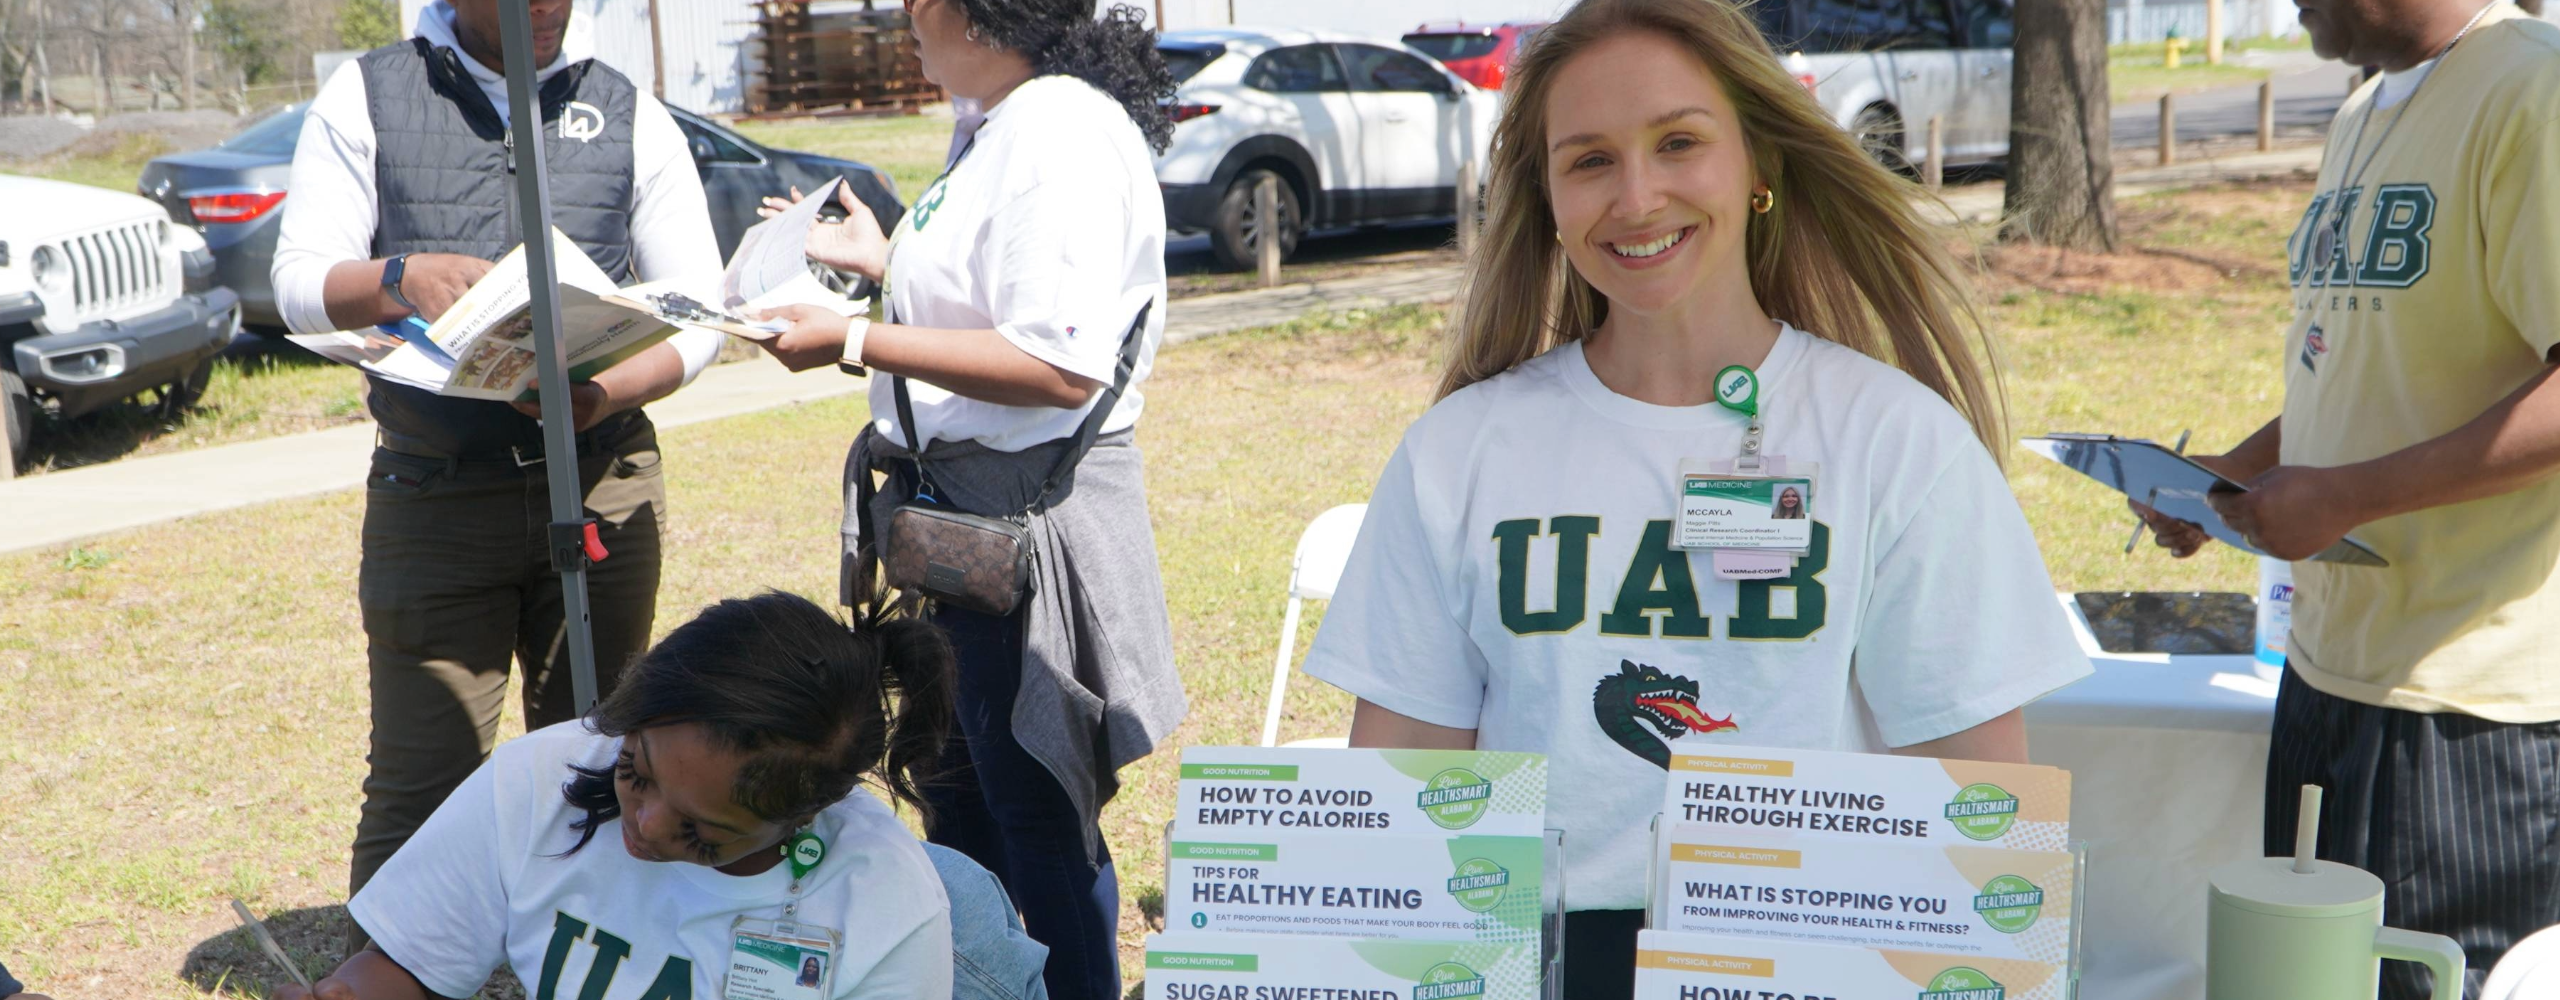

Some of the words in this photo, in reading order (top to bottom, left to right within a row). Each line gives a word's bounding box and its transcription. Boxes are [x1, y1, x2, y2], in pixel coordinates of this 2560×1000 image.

[2287, 183, 2438, 290] UAB
[448, 325, 472, 348] WHAT
[472, 318, 481, 330] IS
[479, 284, 516, 318] STOPPING
[517, 273, 528, 285] YO
[1722, 375, 1748, 398] UAB
[1709, 481, 1752, 489] MEDICINE
[1491, 514, 1831, 642] UAB
[1203, 768, 1226, 776] GOOD
[1228, 768, 1270, 776] NUTRITION
[1687, 759, 1728, 769] PHYSICAL
[1730, 761, 1769, 771] ACTIVITY
[1200, 787, 1257, 804] HOW
[1263, 788, 1293, 805] TO
[1297, 789, 1373, 806] AVOID
[1421, 784, 1489, 806] HEALTHSMART
[1684, 782, 1796, 805] HEALTHY
[1801, 790, 1885, 812] LIVING
[1948, 800, 2016, 817] HEALTHSMART
[1198, 808, 1274, 826] EMPTY
[1278, 810, 1390, 829] CALORIES
[1682, 804, 1804, 829] THROUGH
[1809, 813, 1929, 837] EXERCISE
[797, 845, 819, 858] UAB
[1189, 847, 1214, 855] GOOD
[1216, 848, 1260, 856] NUTRITION
[1695, 849, 1737, 860] PHYSICAL
[1739, 852, 1778, 862] ACTIVITY
[1193, 866, 1225, 879] TIPS
[1229, 867, 1259, 880] FOR
[1450, 872, 1507, 892] HEALTHSMART
[1192, 883, 1316, 906] HEALTHY
[1322, 886, 1423, 910] EATING
[1685, 881, 1752, 901] WHAT
[1757, 887, 1777, 903] IS
[1781, 888, 1894, 911] STOPPING
[1898, 896, 1947, 915] YOU
[1977, 892, 2041, 910] HEALTHSMART
[1196, 915, 1203, 926] 1
[1233, 914, 1291, 923] PROPORTIONS
[1293, 916, 1311, 924] AND
[1313, 917, 1341, 925] FOODS
[1344, 918, 1364, 926] THAT
[1366, 919, 1389, 927] MAKE
[1392, 920, 1415, 928] YOUR
[1416, 921, 1440, 929] BODY
[1463, 922, 1489, 930] GOOD
[1683, 905, 1721, 918] FROM
[1722, 908, 1800, 923] IMPROVING
[1801, 913, 1838, 926] YOUR
[1841, 917, 1893, 930] HEALTH
[1895, 920, 1906, 931] &
[1908, 921, 1970, 935] FITNESS?
[1682, 924, 1715, 933] Improving
[1716, 926, 1731, 934] your
[1733, 927, 1754, 935] health
[1770, 930, 1792, 938] fitness
[1827, 934, 1868, 944] challenging,
[1870, 937, 1882, 945] but
[1896, 939, 1924, 948] benefits
[1936, 942, 1969, 951] outweigh
[752, 941, 786, 953] MEDICINE
[733, 963, 769, 976] BRITTANY
[1162, 956, 1188, 965] GOOD
[1189, 957, 1234, 966] NUTRITION
[1667, 956, 1710, 967] PHYSICAL
[1712, 959, 1752, 971] ACTIVITY
[1166, 982, 1250, 1000] SUGAR
[1417, 980, 1482, 1000] HEALTHSMART
[1680, 984, 1752, 1000] HOW
